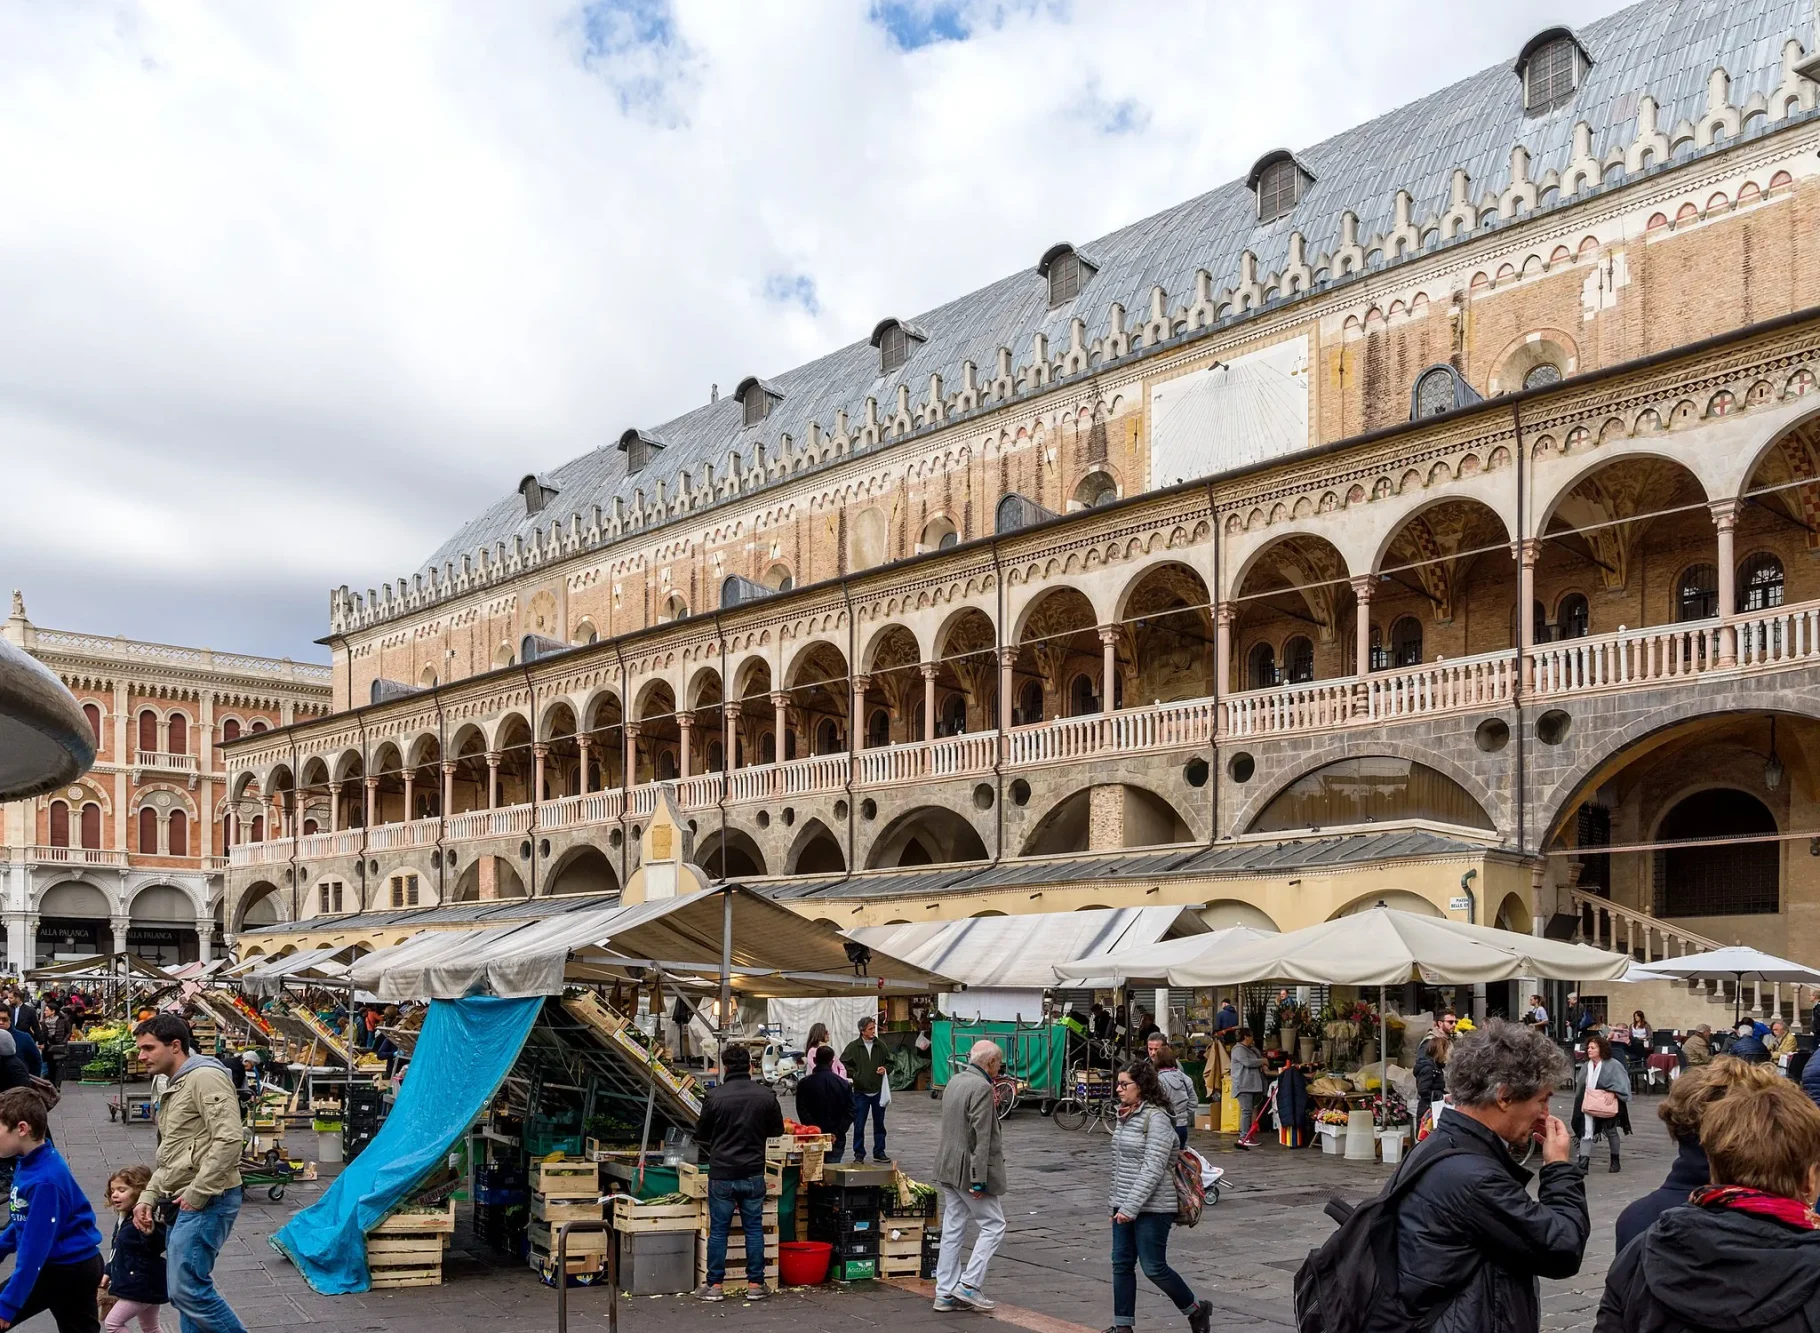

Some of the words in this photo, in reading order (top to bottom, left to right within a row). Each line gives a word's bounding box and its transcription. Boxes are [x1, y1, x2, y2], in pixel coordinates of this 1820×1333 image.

[40, 928, 57, 936] ALLA
[58, 929, 89, 938] PALANCA
[143, 931, 172, 940] PALANCA
